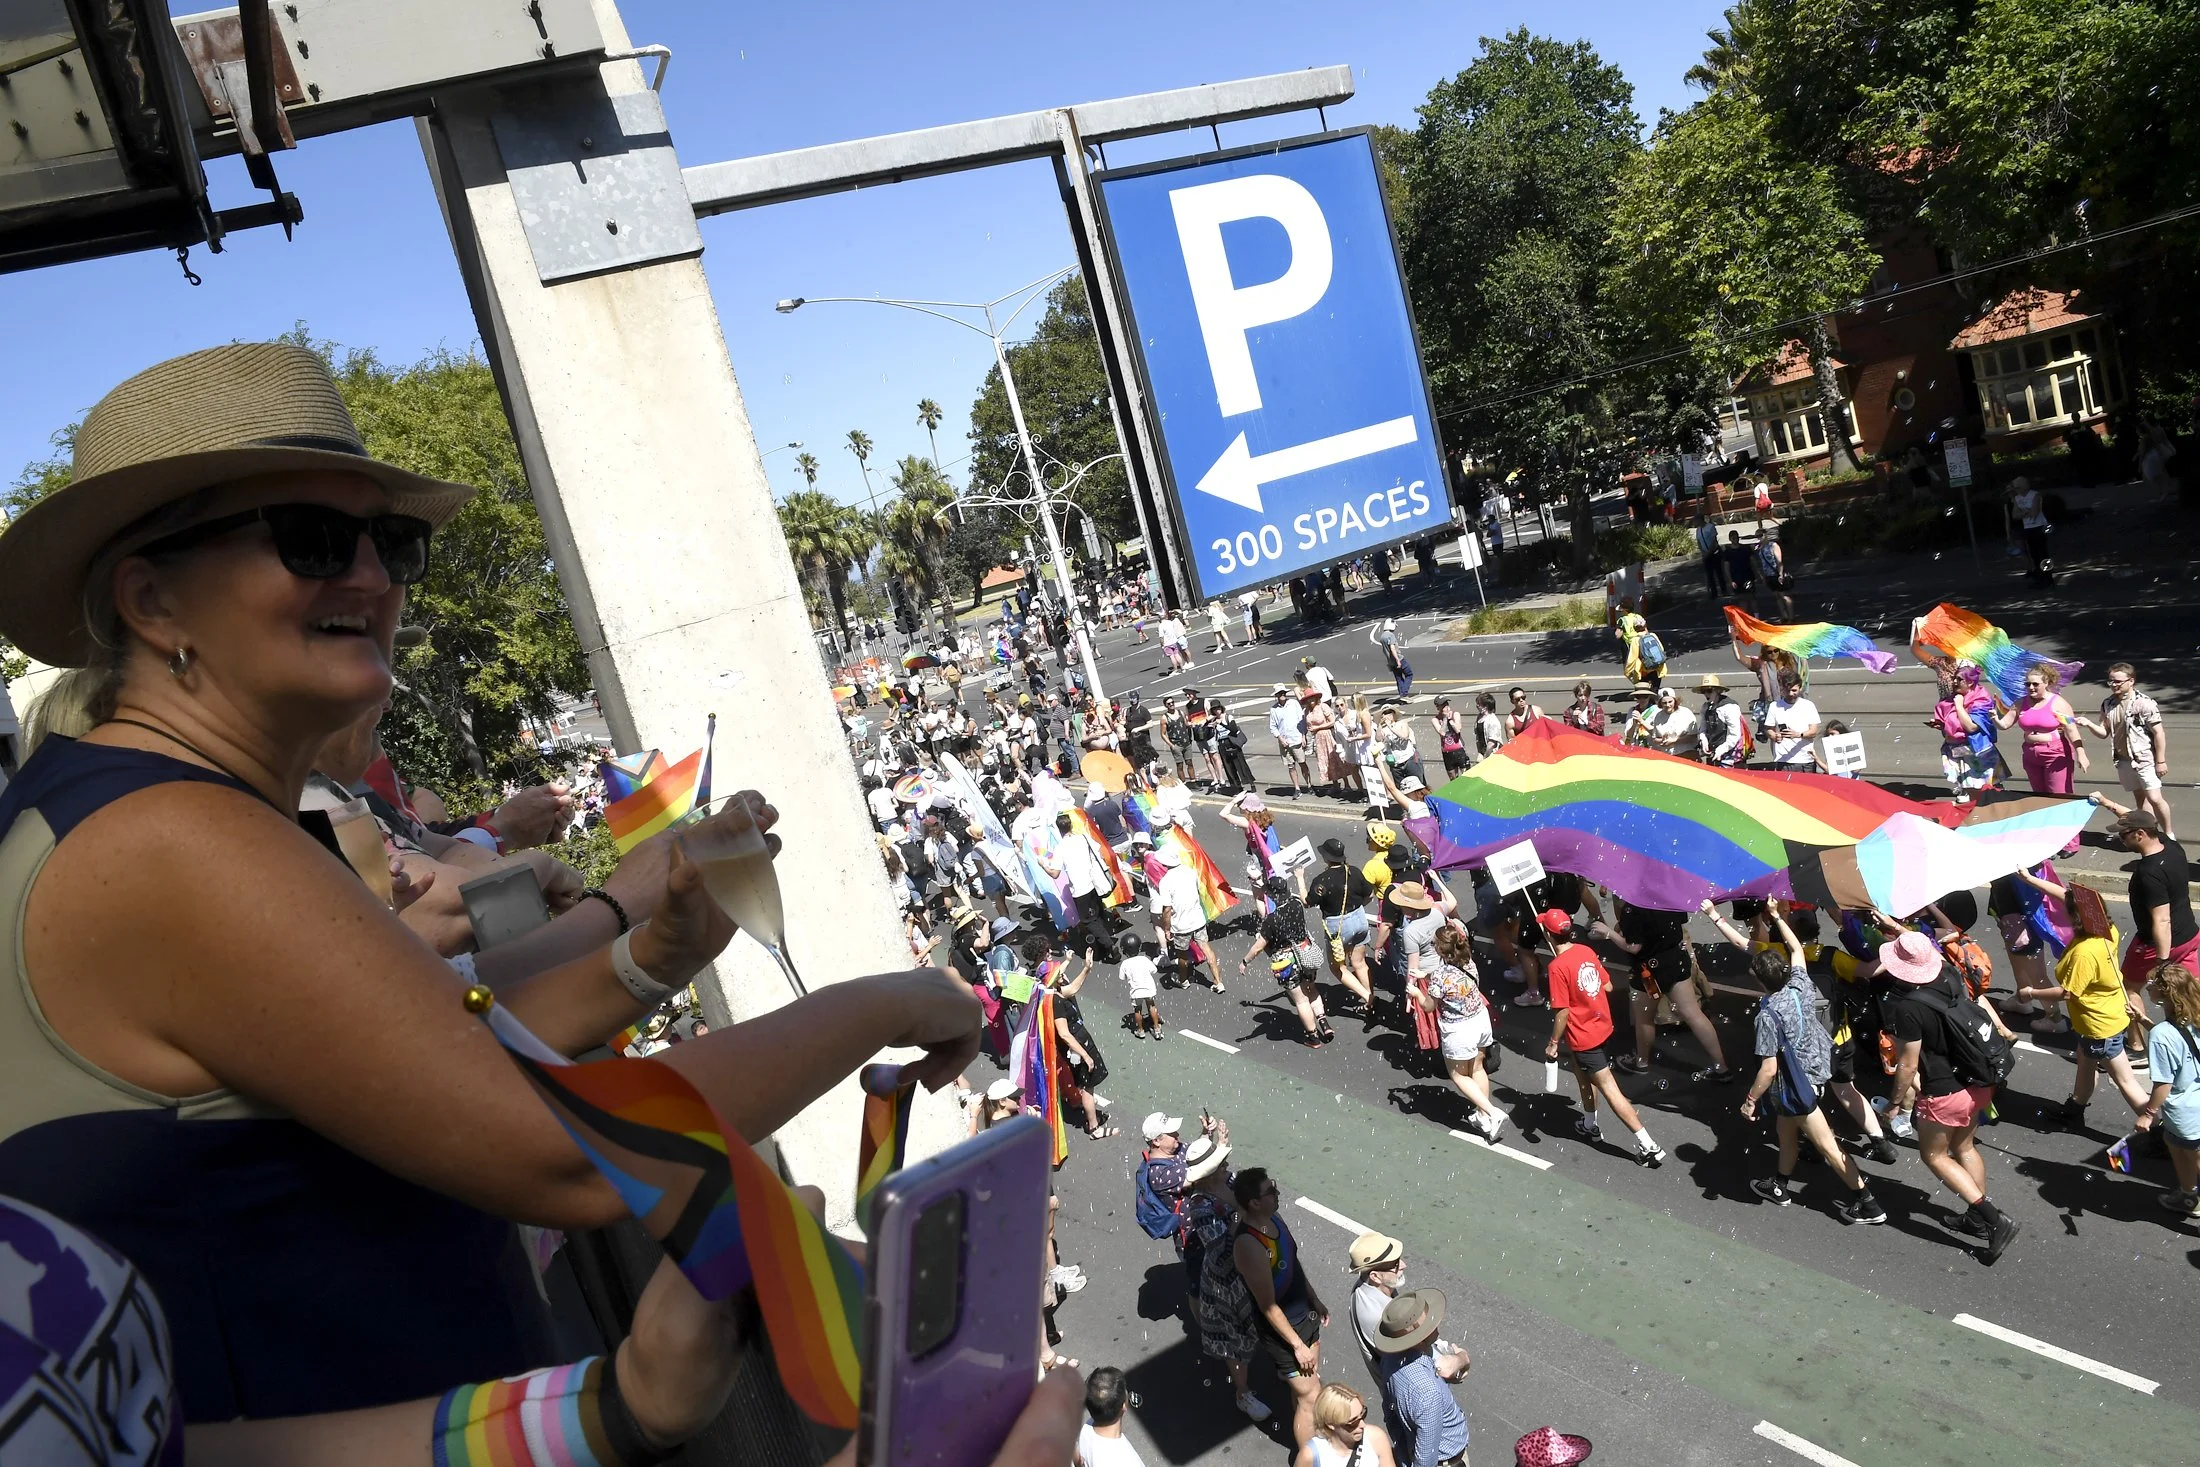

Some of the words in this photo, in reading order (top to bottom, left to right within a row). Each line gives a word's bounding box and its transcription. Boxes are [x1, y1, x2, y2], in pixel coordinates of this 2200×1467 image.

[1168, 174, 1334, 418] P
[1211, 524, 1284, 575] 300
[1293, 480, 1431, 551] SPACES
